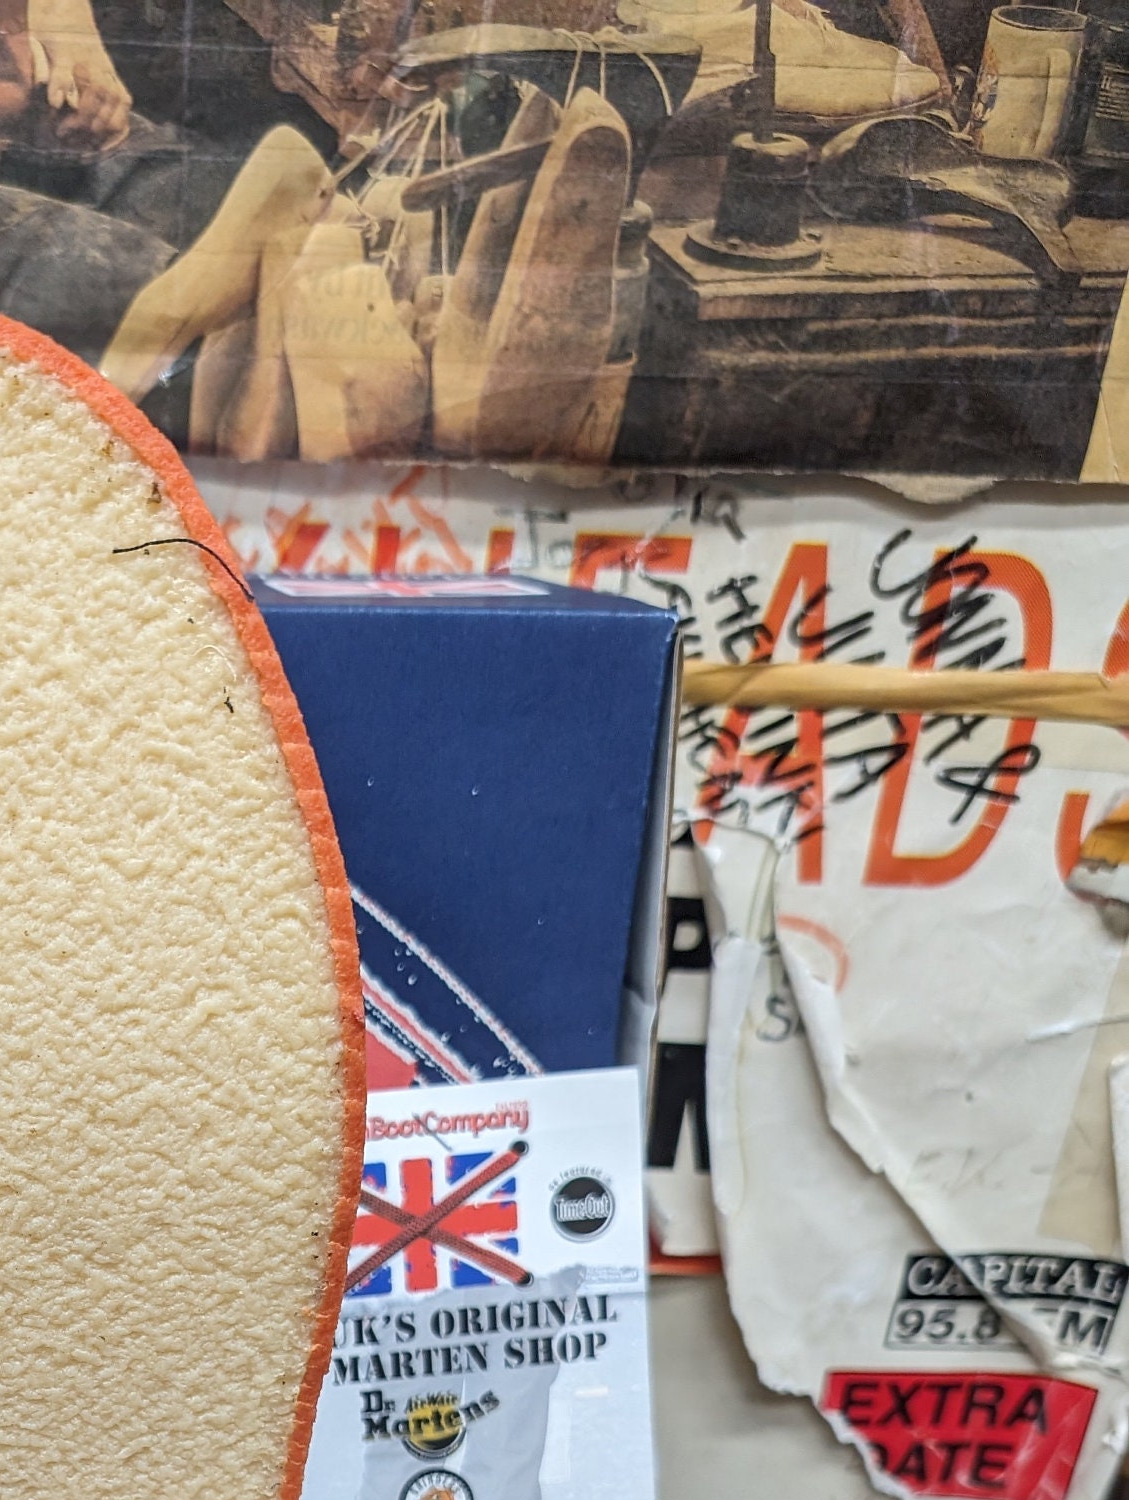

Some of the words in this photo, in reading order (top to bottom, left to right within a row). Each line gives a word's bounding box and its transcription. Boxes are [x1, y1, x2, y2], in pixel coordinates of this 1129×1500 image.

[429, 1294, 618, 1339] ORIGINAL
[895, 1306, 1003, 1341] 95.8
[332, 1341, 488, 1387] MARTEN
[503, 1330, 607, 1369] SHOP
[361, 1388, 501, 1441] Martens
[840, 1380, 1048, 1436] EXTRA
